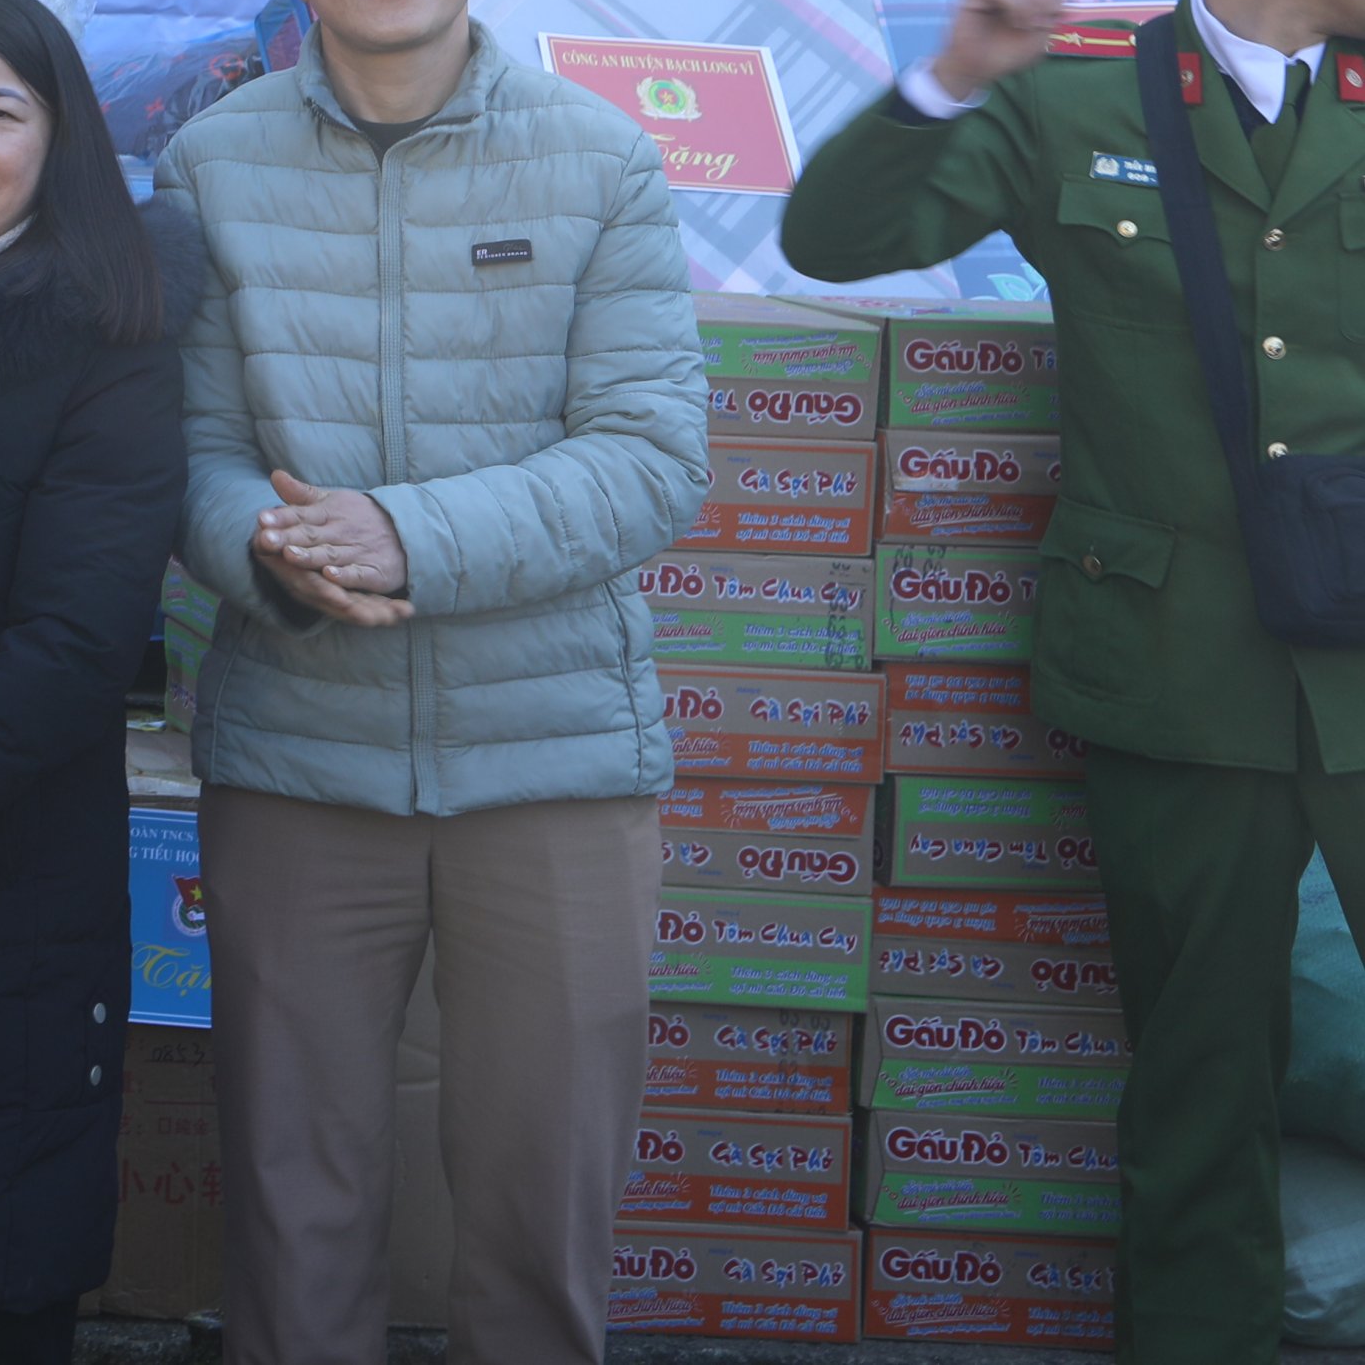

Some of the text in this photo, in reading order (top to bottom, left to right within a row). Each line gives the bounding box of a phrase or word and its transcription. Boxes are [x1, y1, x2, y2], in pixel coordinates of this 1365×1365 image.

[562, 49, 598, 66] CÔNG
[601, 52, 619, 67] AN
[621, 54, 664, 73] HUYỆN
[666, 57, 701, 75] BẠCH
[703, 59, 738, 75] LONG
[739, 468, 859, 498] Gà Sợi Phở
[130, 826, 194, 842] OÀN TNCS
